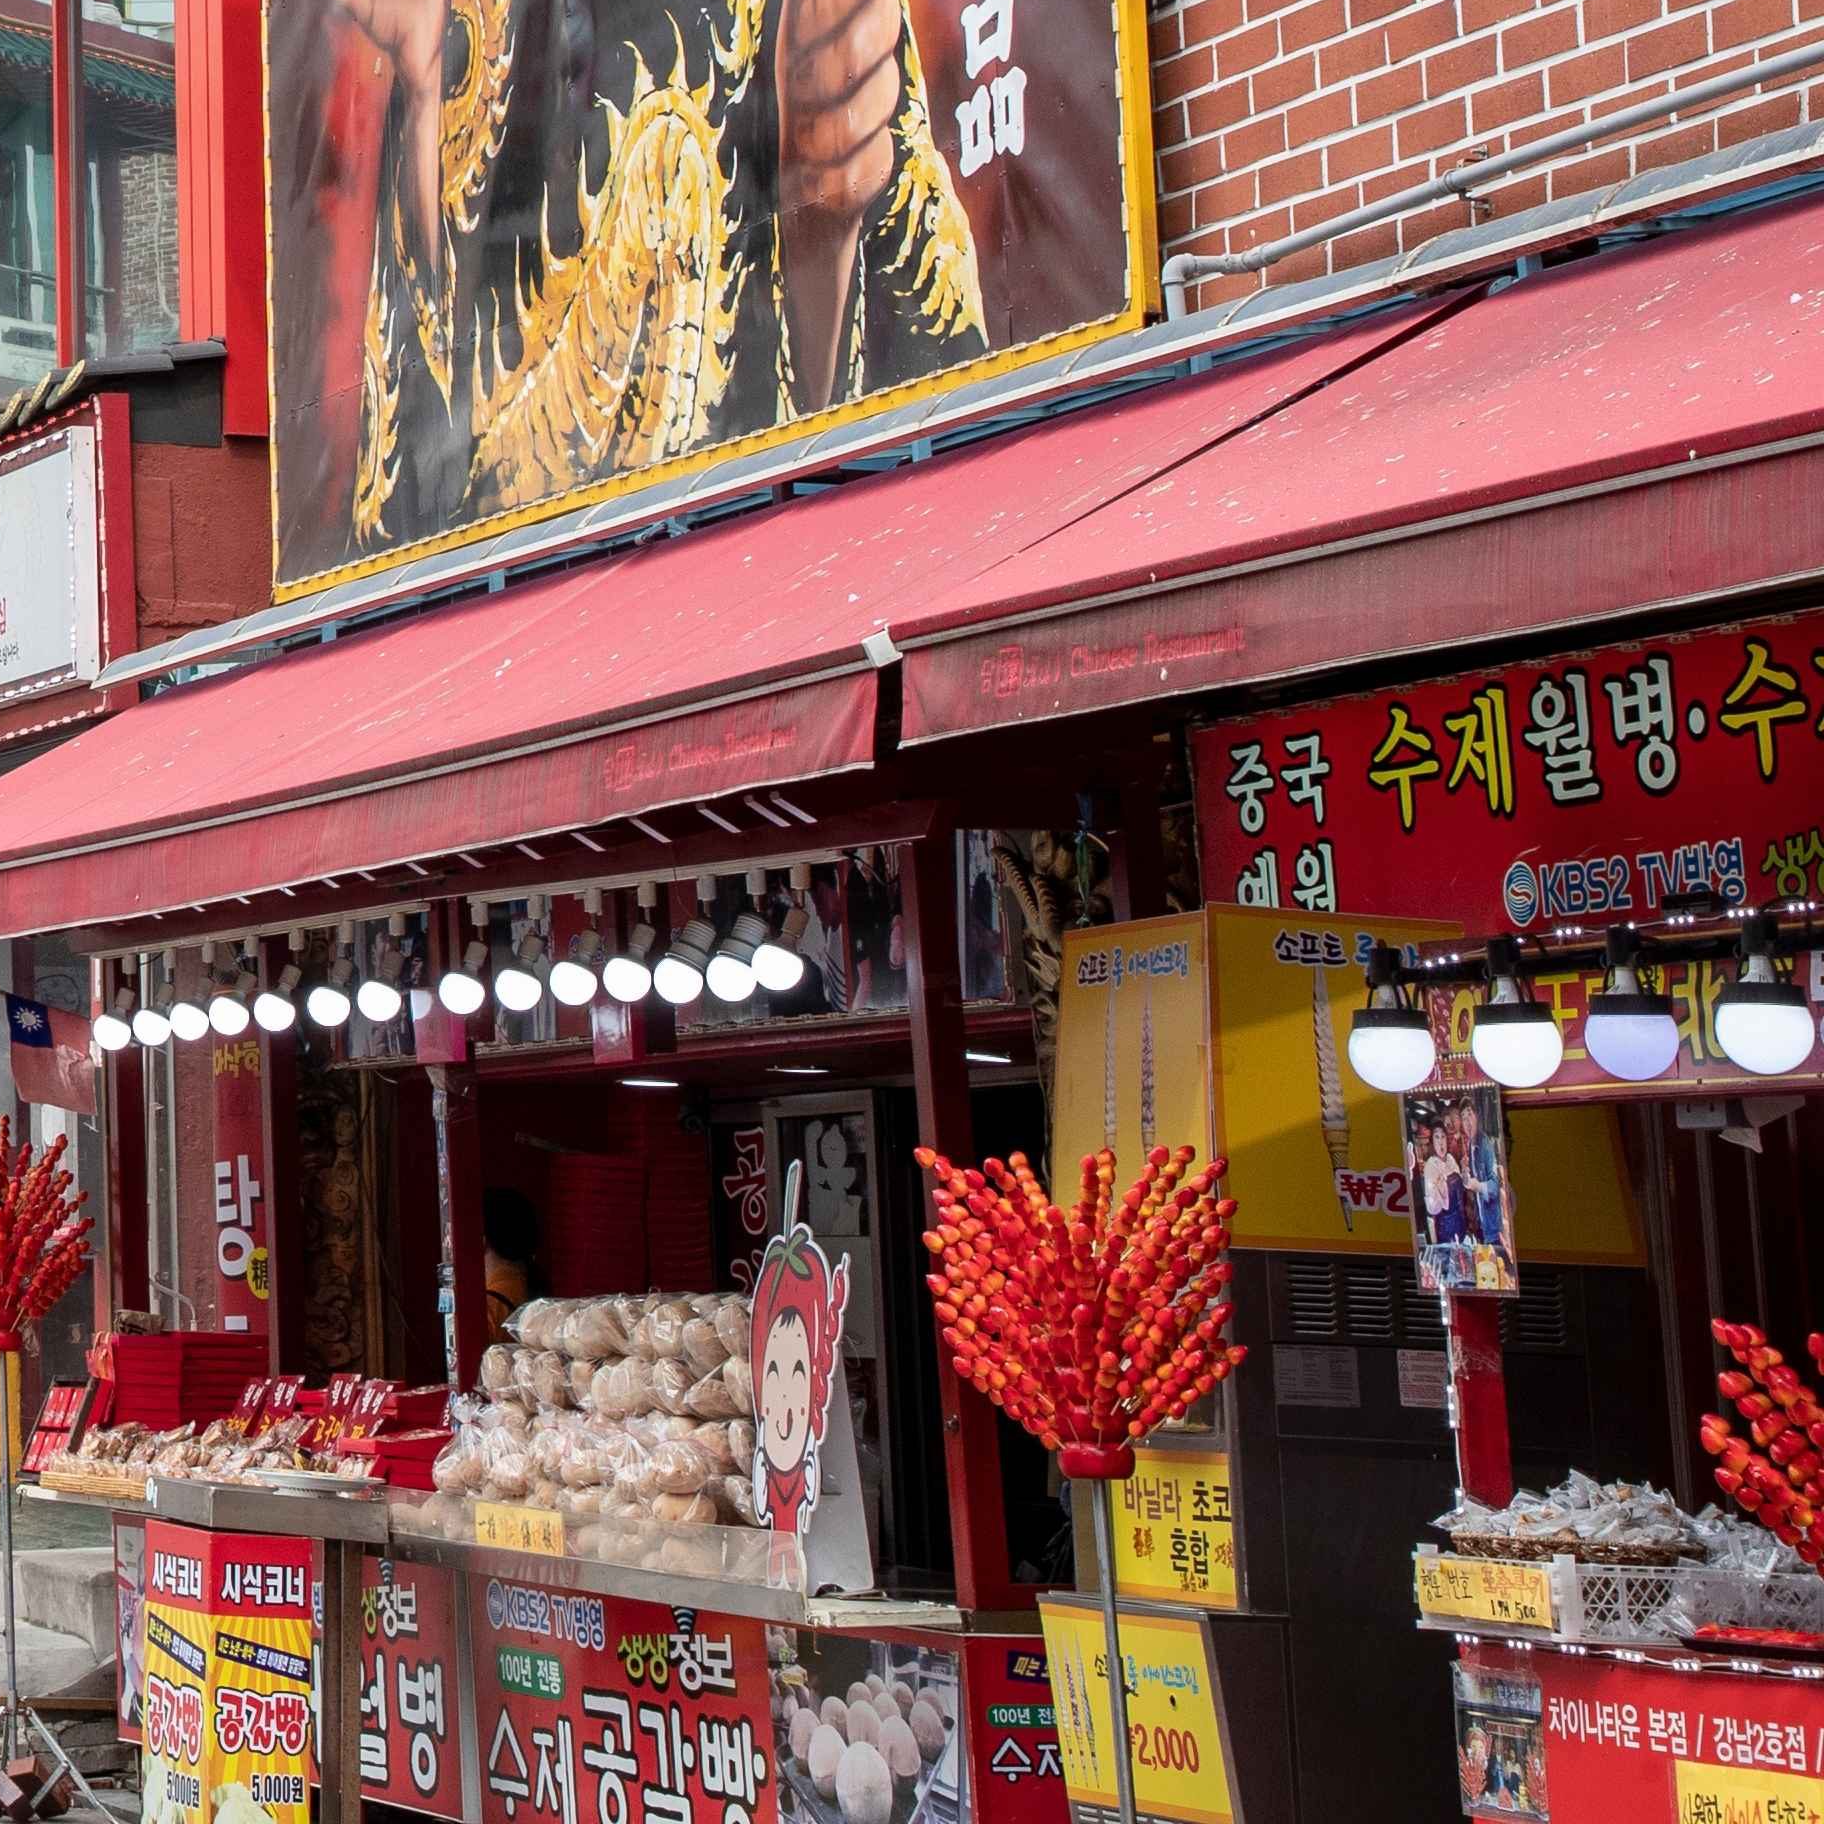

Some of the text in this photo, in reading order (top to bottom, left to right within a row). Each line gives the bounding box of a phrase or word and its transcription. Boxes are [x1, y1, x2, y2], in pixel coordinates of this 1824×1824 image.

[1369, 643, 1824, 832] 수제월병·수
[1227, 734, 1330, 833] 중국
[1541, 837, 1746, 917] KBS2 TV방영
[1274, 930, 1347, 966] 소프트
[1124, 1476, 1233, 1524] 바닐라 초코
[152, 1552, 202, 1600] 시식코너
[1170, 1527, 1210, 1576] 혼합
[221, 1563, 305, 1606] 시식코너
[504, 1583, 606, 1651] KBS2 TV방영
[498, 1653, 562, 1696] 100년 전통
[617, 1632, 738, 1692] 생생정보
[148, 1674, 202, 1764] 공갈빵
[217, 1688, 310, 1755] 공갈빵
[992, 1709, 1031, 1726] 100년
[1549, 1697, 1641, 1750] 차이나타운
[1649, 1699, 1688, 1757] 본점
[1713, 1717, 1807, 1771] 강남2호점
[252, 1774, 304, 1804] 5,000원
